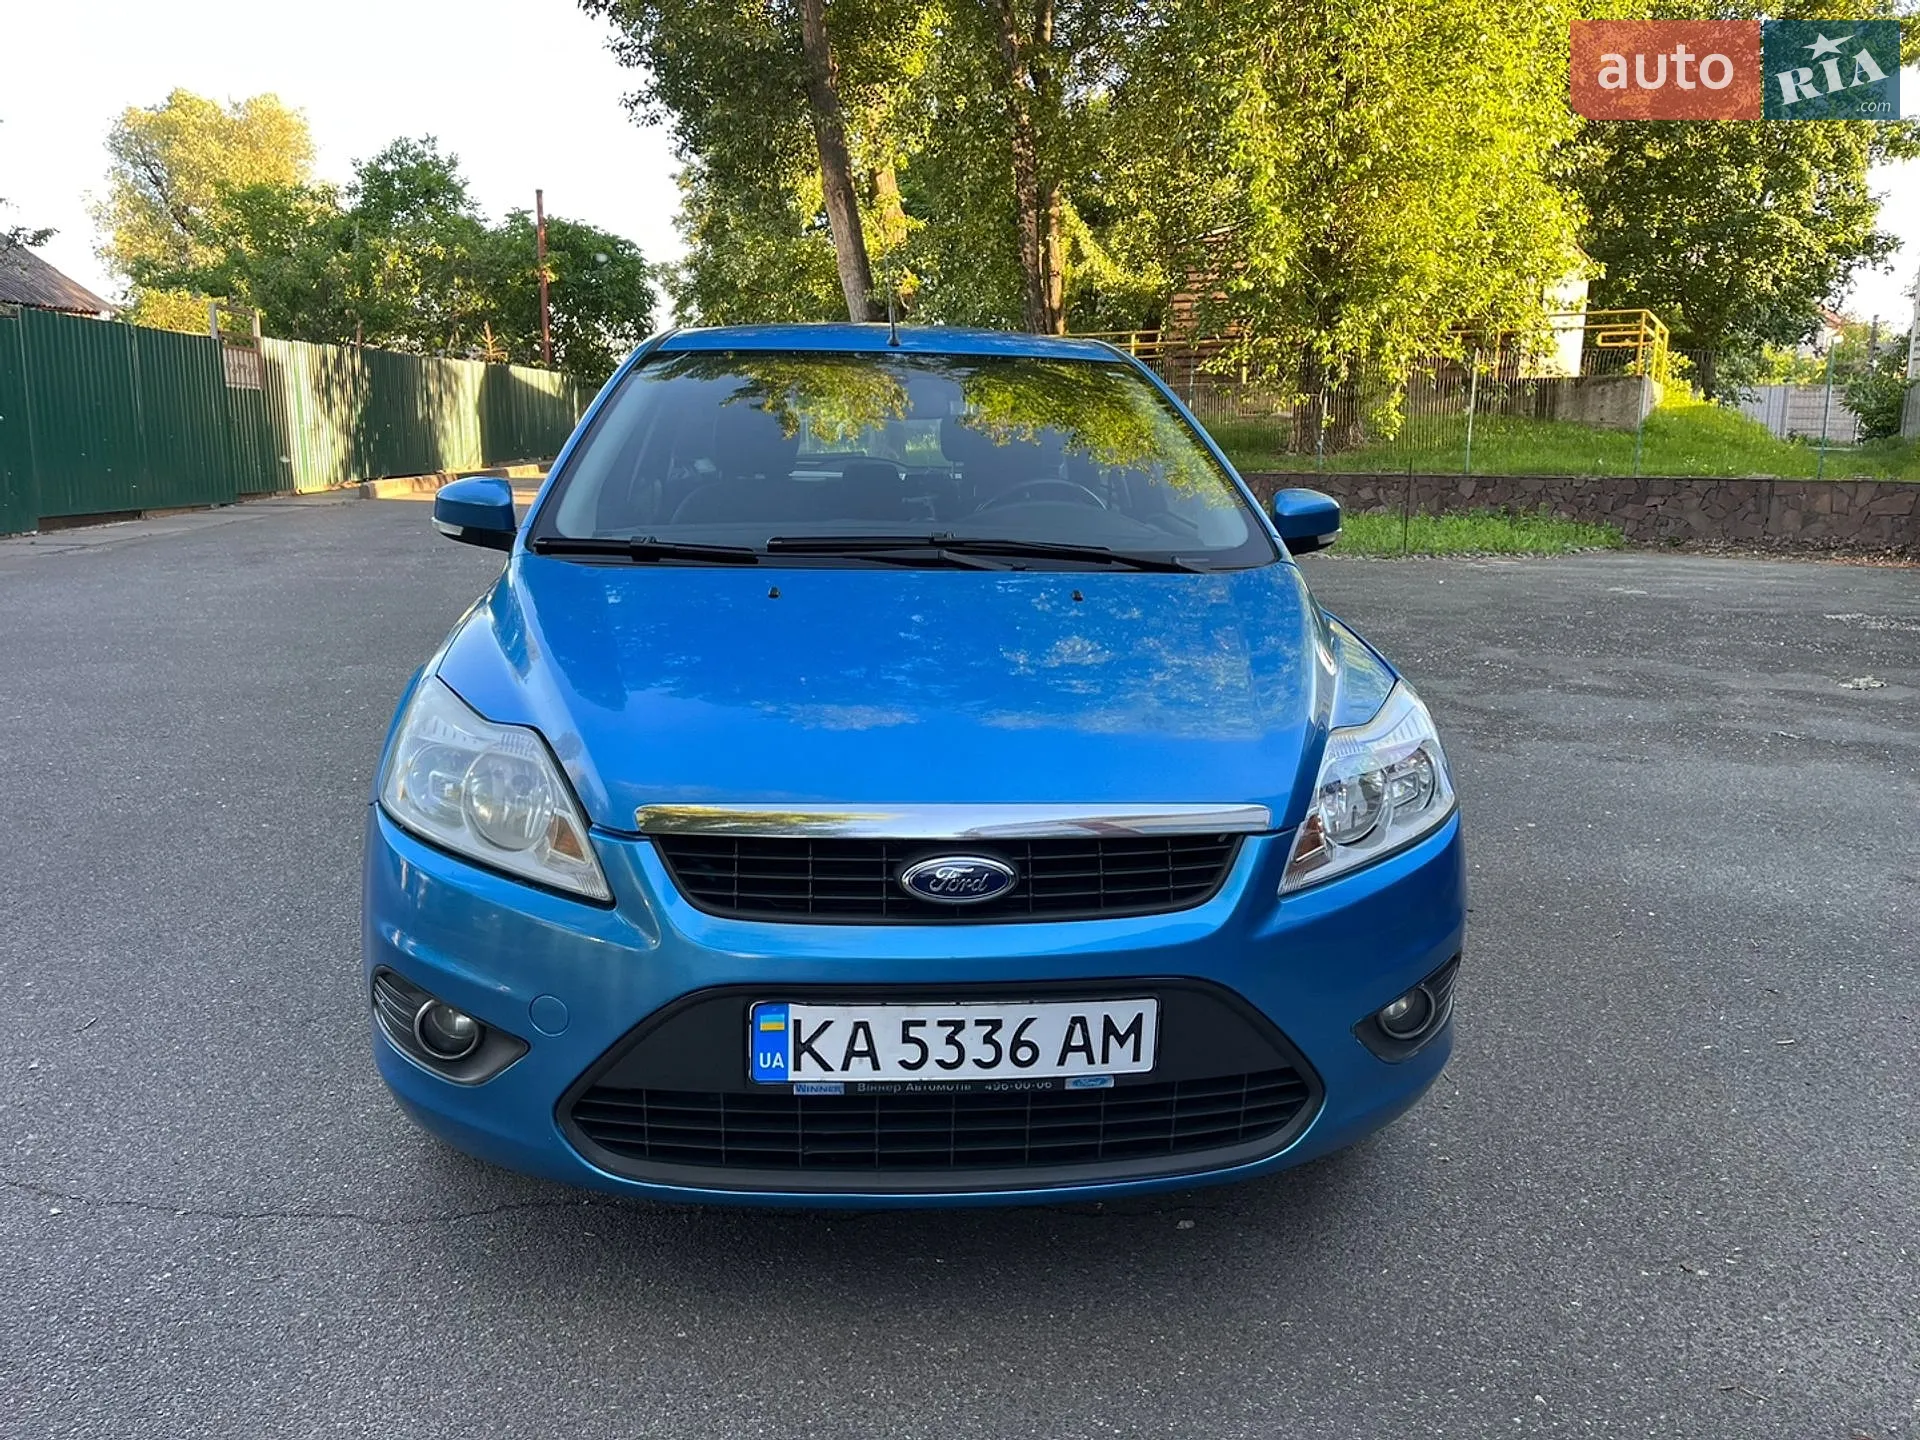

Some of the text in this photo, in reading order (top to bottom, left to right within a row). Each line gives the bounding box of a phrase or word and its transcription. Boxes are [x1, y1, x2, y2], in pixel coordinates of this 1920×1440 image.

[929, 866, 990, 892] Ford
[792, 1011, 1145, 1073] KA 5336 AM
[759, 1051, 785, 1069] UA
